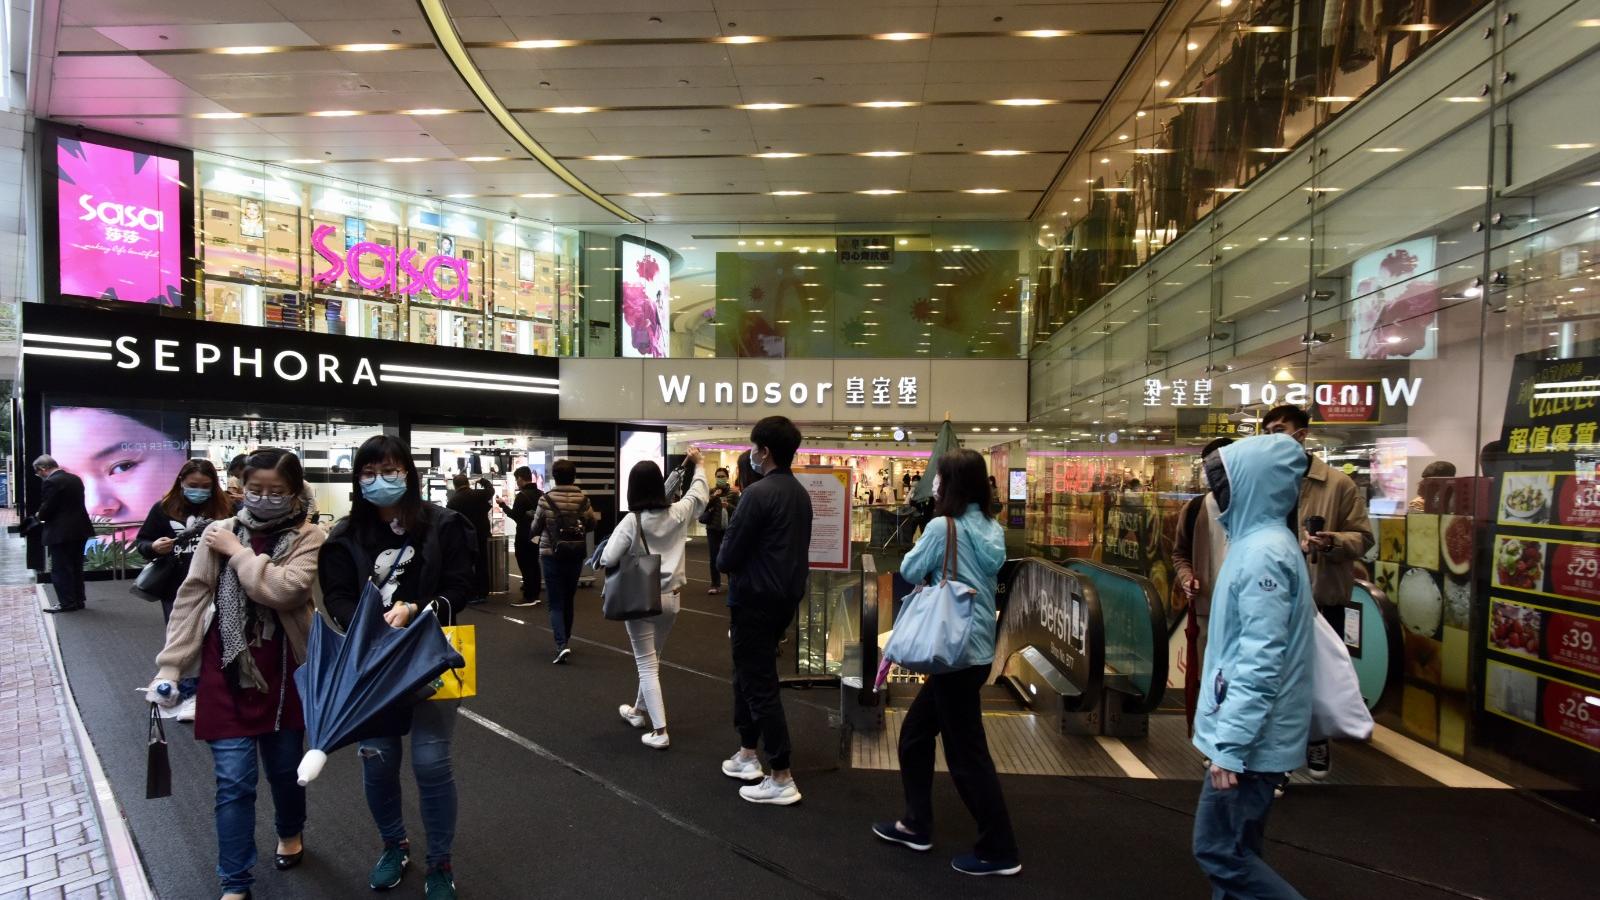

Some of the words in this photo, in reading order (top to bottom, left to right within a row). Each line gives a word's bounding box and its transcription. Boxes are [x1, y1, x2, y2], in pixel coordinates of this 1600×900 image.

[115, 335, 379, 387] SEPHORA
[845, 375, 919, 406] 皇室堡
[1567, 557, 1598, 578] $29
[1041, 589, 1087, 656] Bersha
[1562, 628, 1593, 651] $39
[1558, 698, 1589, 722] $26
